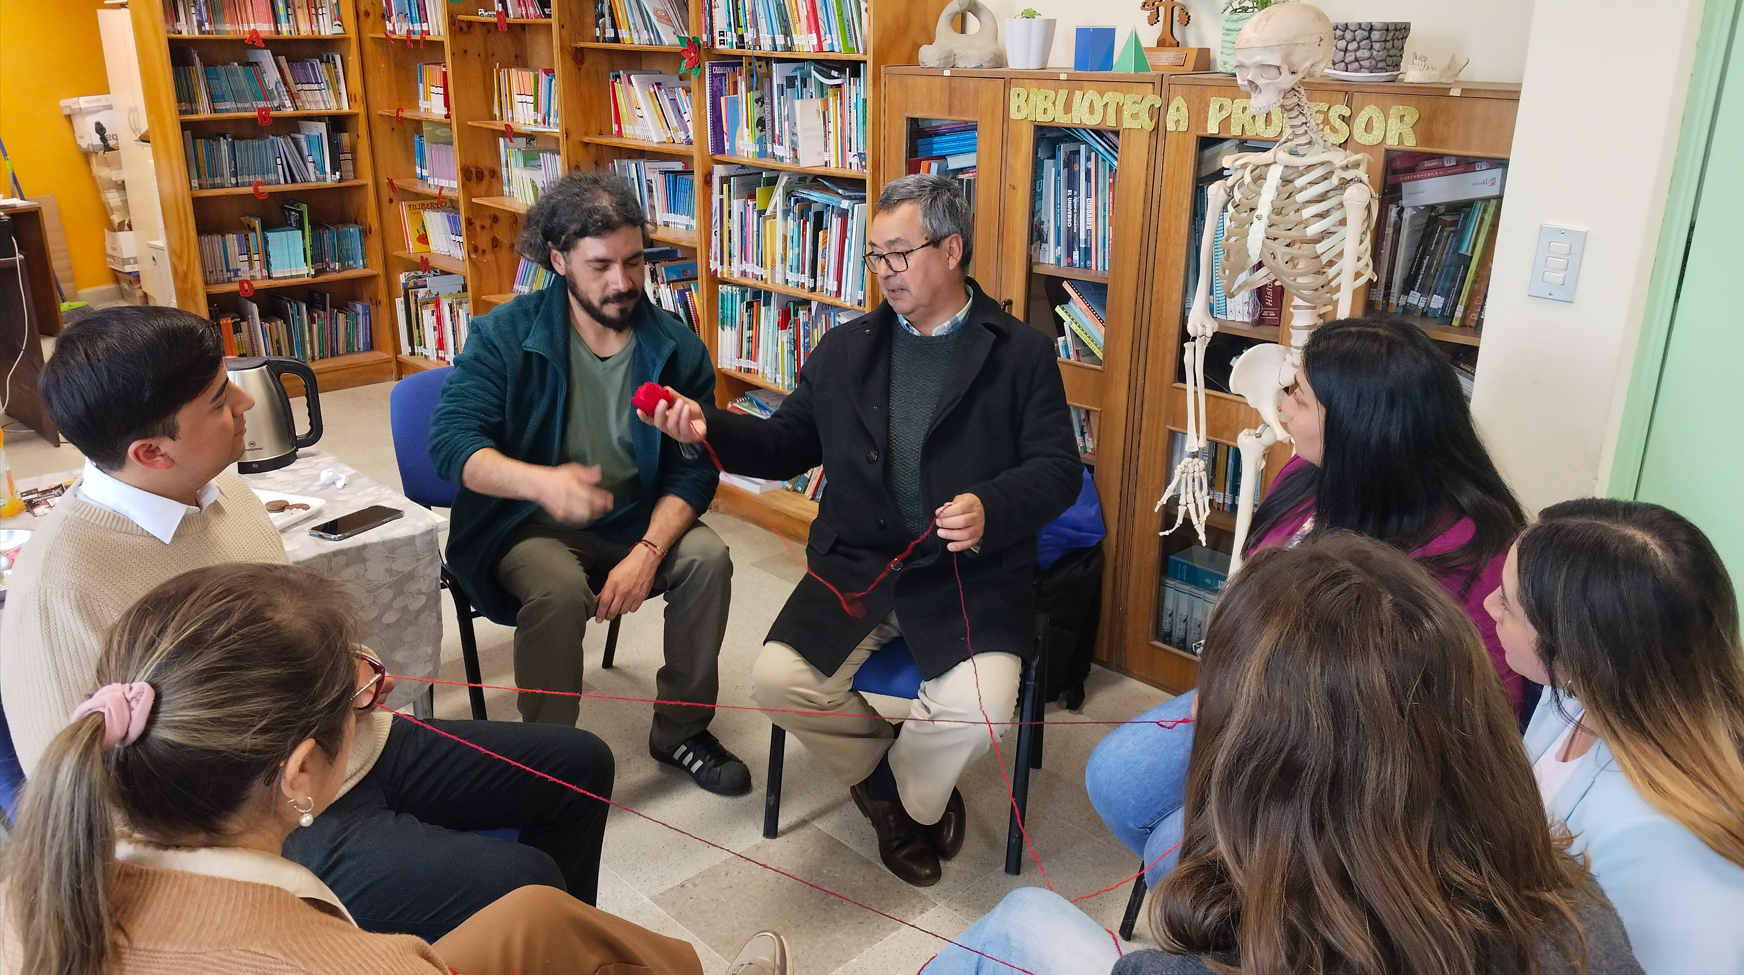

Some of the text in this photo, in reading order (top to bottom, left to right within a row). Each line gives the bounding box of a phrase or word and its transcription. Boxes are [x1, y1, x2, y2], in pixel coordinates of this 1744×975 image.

[244, 28, 265, 48] A
[257, 106, 273, 126] B
[1207, 97, 1420, 147] PROESOR
[105, 133, 119, 143] eq
[253, 180, 269, 200] C
[1067, 189, 1073, 197] EL
[237, 278, 255, 297] D
